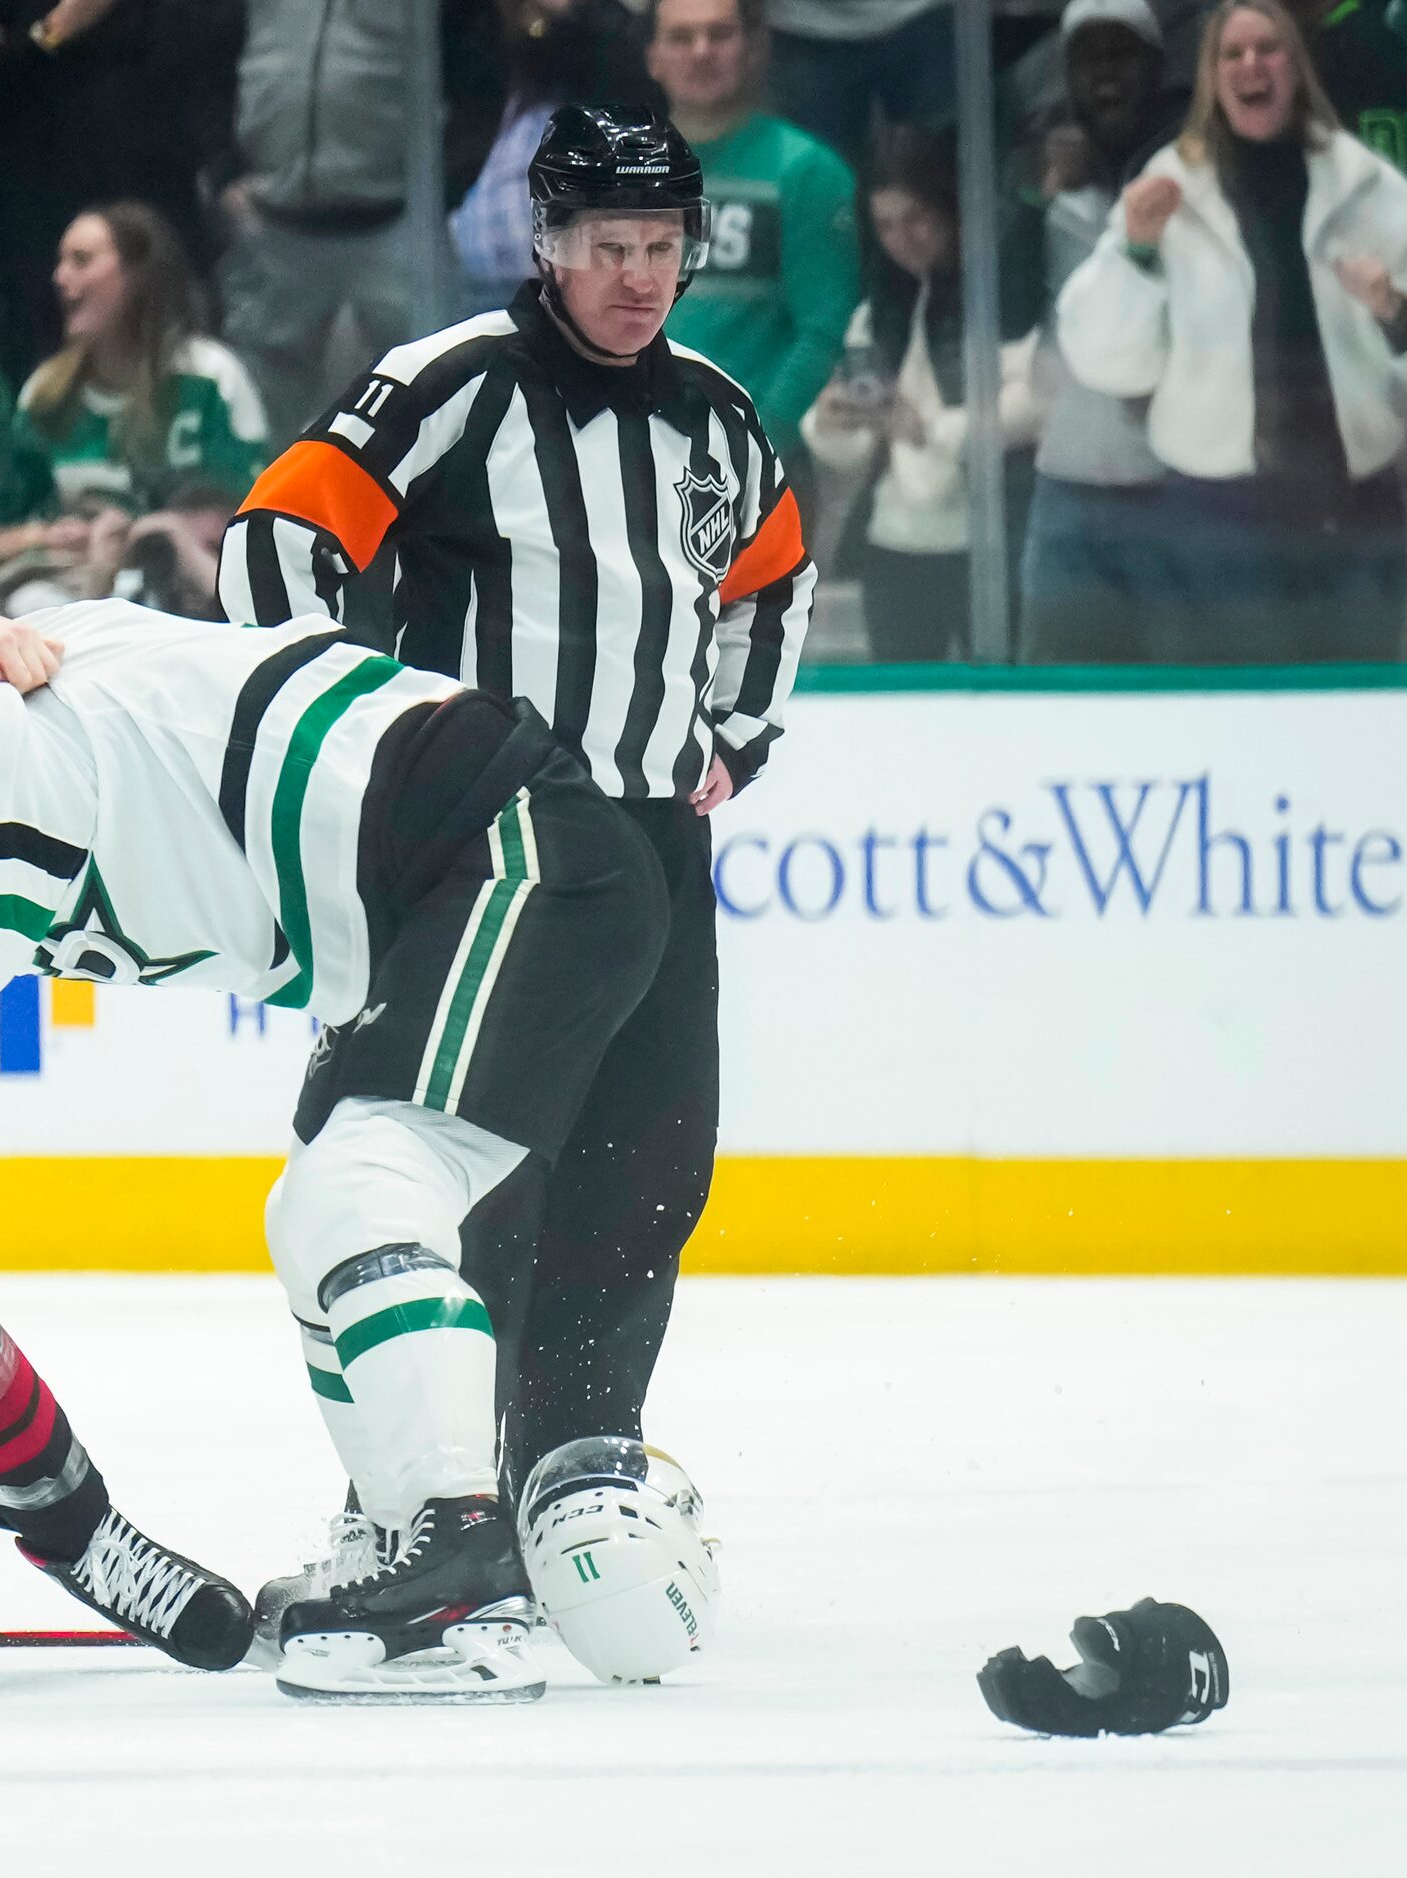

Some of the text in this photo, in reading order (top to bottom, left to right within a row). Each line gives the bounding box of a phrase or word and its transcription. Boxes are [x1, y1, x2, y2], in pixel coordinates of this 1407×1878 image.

[615, 165, 670, 175] WARRIOR
[353, 379, 395, 418] 11
[697, 506, 730, 555] NHL
[571, 1551, 601, 1584] 11
